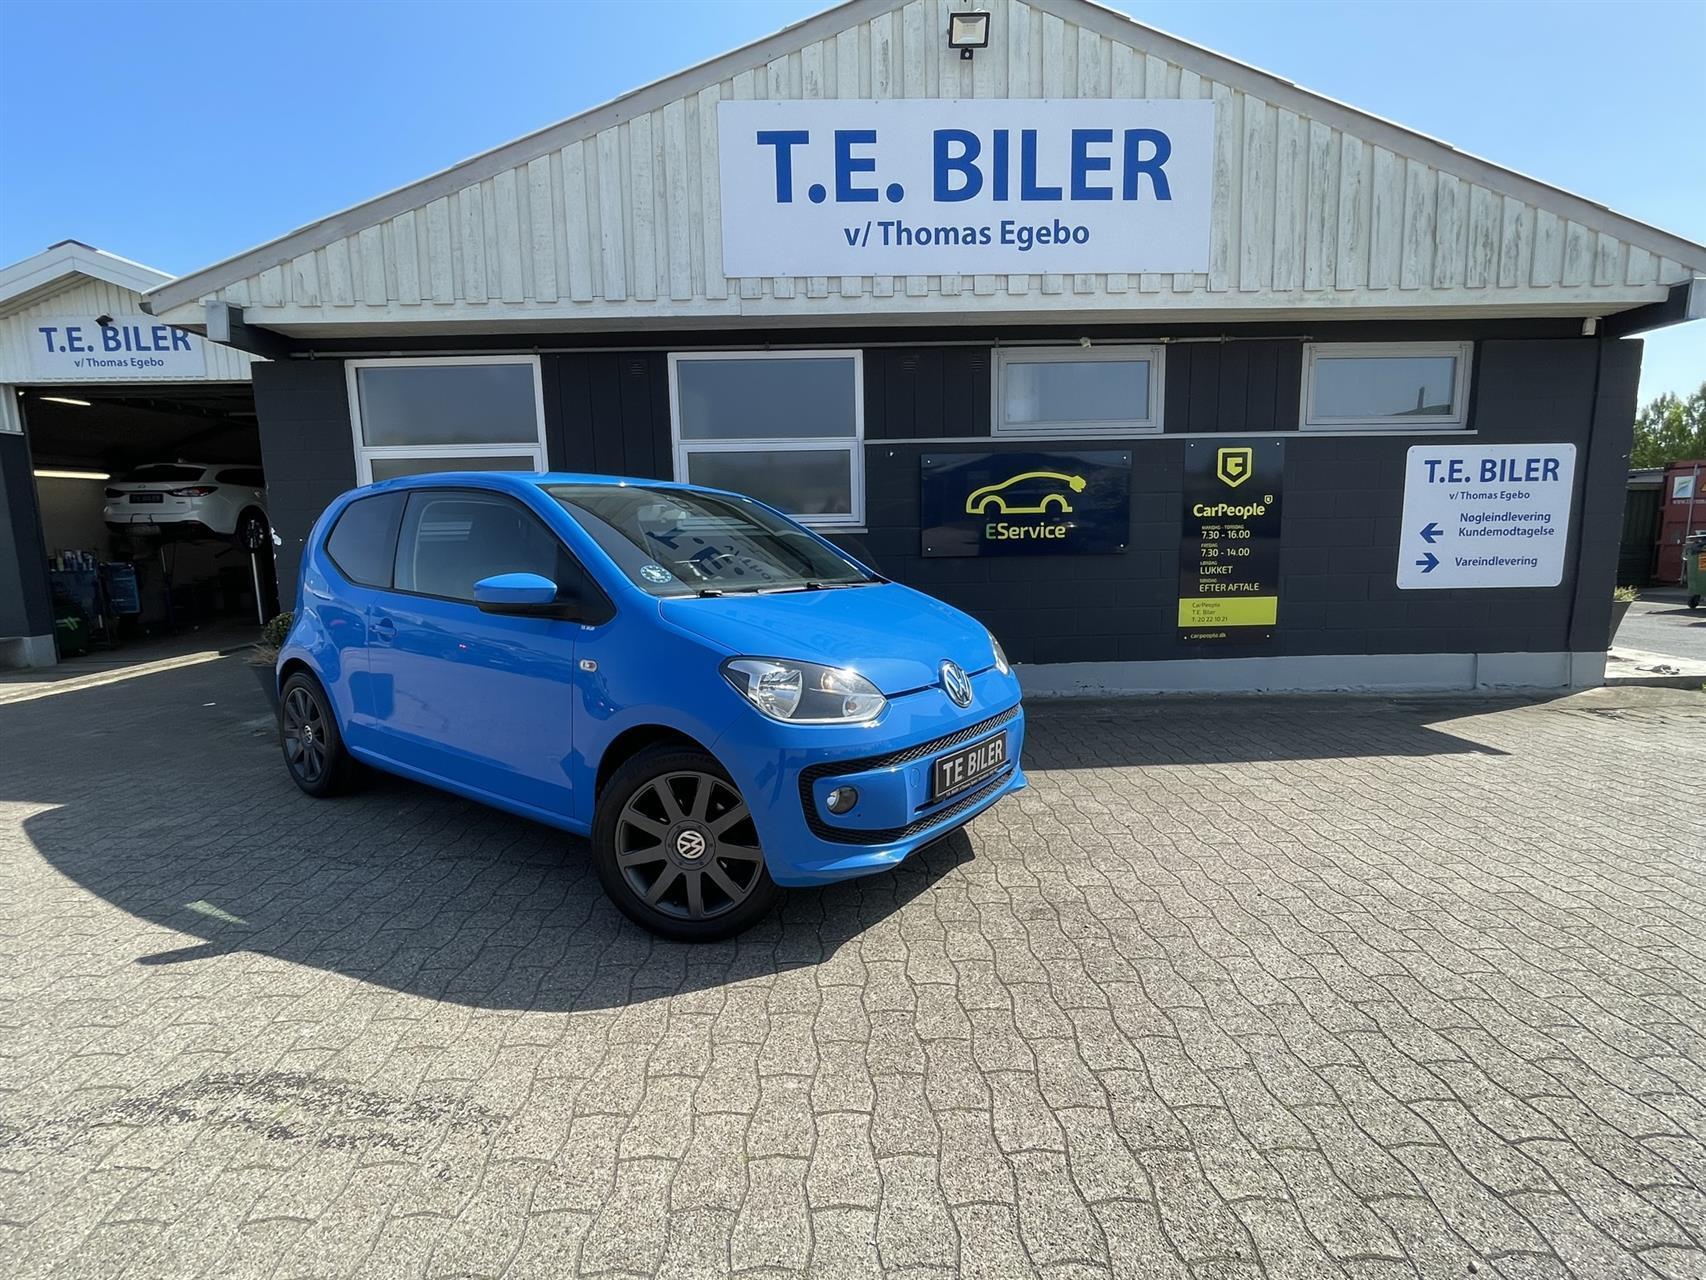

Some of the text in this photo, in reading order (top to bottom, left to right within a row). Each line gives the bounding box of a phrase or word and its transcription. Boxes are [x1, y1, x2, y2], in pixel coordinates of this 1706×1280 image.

[756, 128, 1173, 204] T.E. BILER
[843, 219, 1090, 251] v/ Thomas Egebo
[38, 325, 192, 353] T.E. BILER
[74, 357, 164, 369] v/ Thomas Egebo
[1424, 458, 1560, 484] T.E. BILER
[1448, 490, 1530, 502] v/ Thomas Egebo
[1193, 502, 1266, 519] CarPeople
[1459, 511, 1551, 524] Nøgleindlevering
[985, 521, 1066, 540] EService
[1201, 530, 1219, 539] 7.30
[1227, 530, 1251, 539] 16.00
[1458, 526, 1555, 538] Kundemodtagelse
[1201, 548, 1219, 557] 7.30
[1226, 547, 1250, 556] 14.00
[1454, 556, 1538, 567] Vareindlevering
[1200, 565, 1233, 575] LUKKET
[1199, 582, 1260, 592] EFTER AFTALE
[967, 739, 1003, 777] BILER
